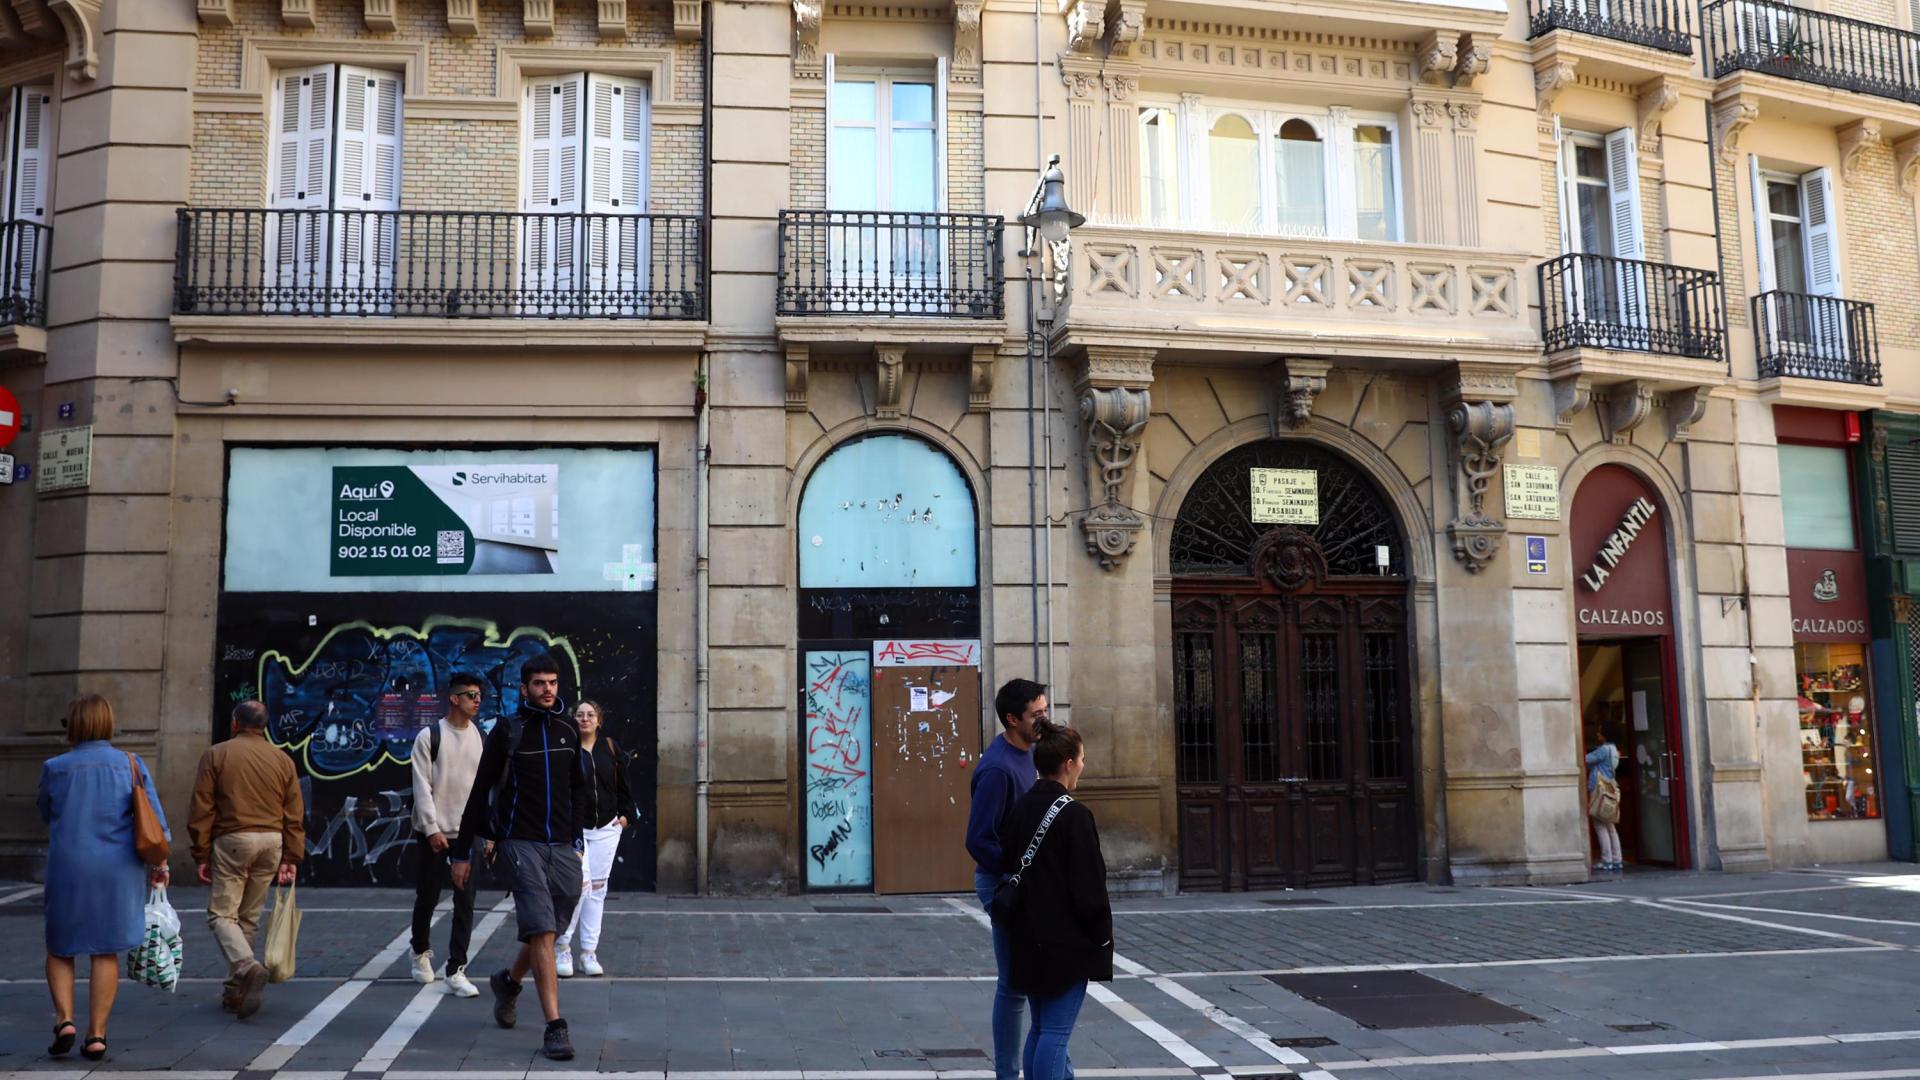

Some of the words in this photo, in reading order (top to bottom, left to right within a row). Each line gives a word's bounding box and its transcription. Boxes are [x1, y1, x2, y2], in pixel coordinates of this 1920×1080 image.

[471, 472, 548, 485] Servihabitat
[1525, 472, 1541, 480] CALLE
[340, 483, 378, 501] Aquí
[340, 508, 379, 522] Local
[339, 522, 417, 540] Disponible
[338, 545, 368, 558] 902
[370, 545, 388, 558] 15
[390, 545, 409, 558] 01
[412, 545, 432, 558] 02
[1583, 563, 1610, 592] LA
[1599, 497, 1656, 568] INFANTIL
[1579, 609, 1664, 625] CALZADOS
[1792, 618, 1865, 634] CALZADOS
[1038, 805, 1060, 834] BIMBA
